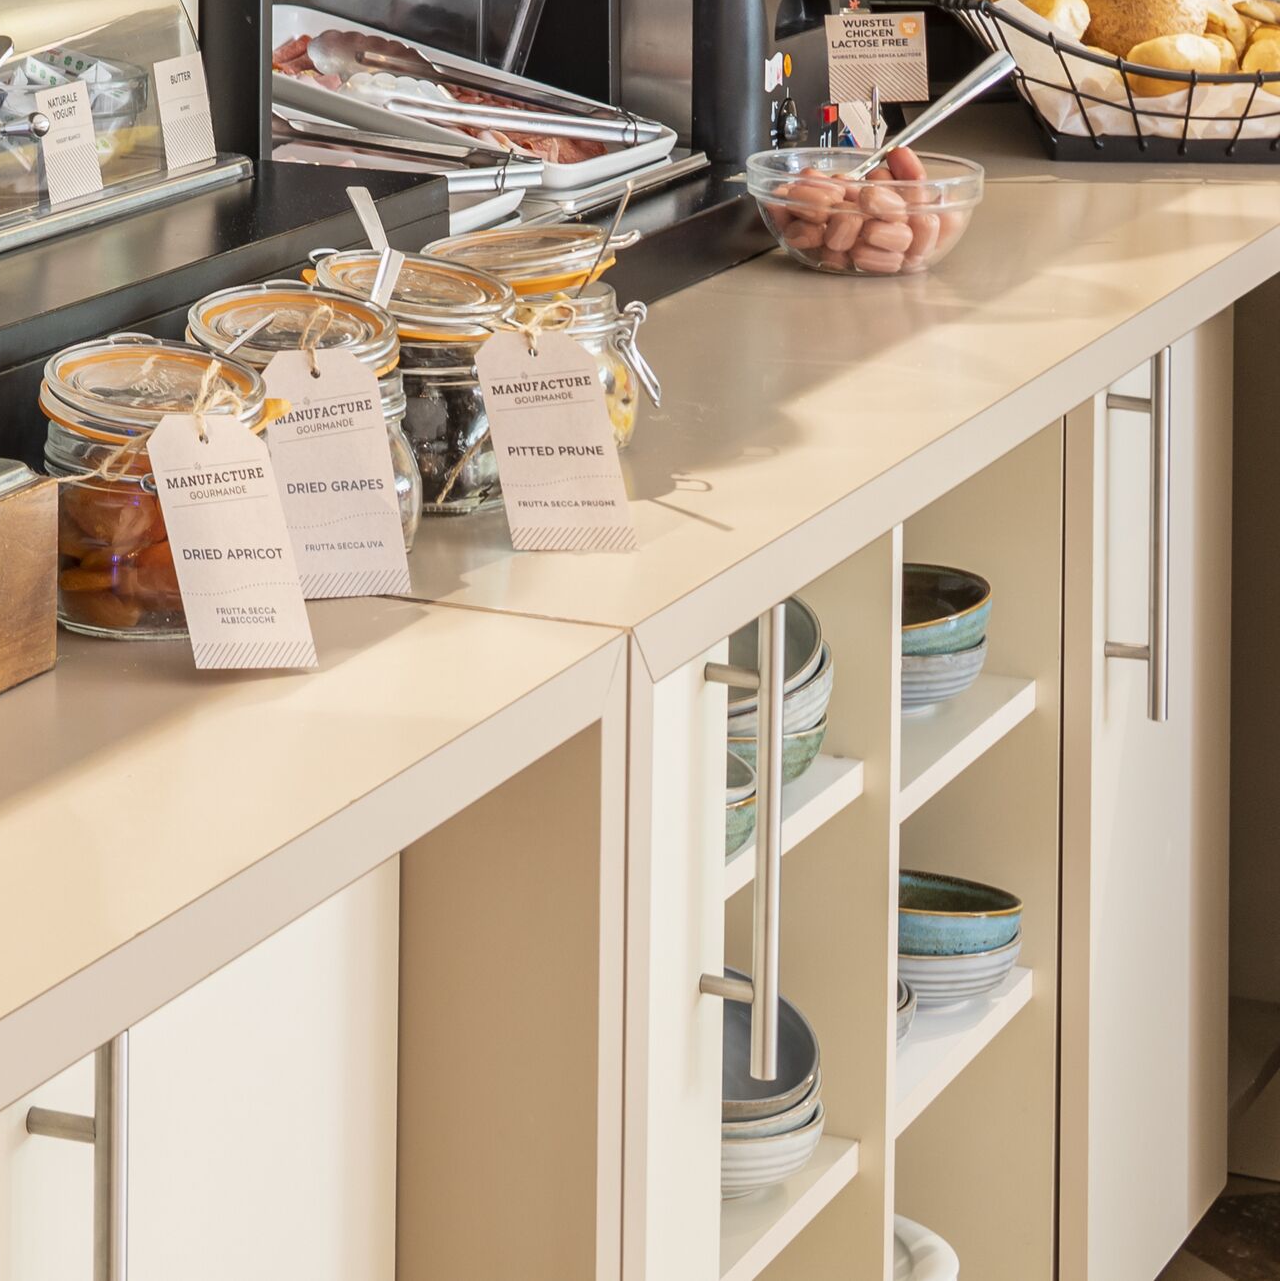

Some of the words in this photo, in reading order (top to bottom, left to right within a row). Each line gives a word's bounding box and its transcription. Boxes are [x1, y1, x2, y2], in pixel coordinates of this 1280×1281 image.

[843, 19, 895, 28] WURSTEL
[845, 29, 893, 38] CHICKEN
[831, 39, 879, 49] LACTOSE
[882, 38, 908, 47] FREE
[170, 71, 191, 85] BUTTER
[47, 92, 78, 109] NATURALE
[52, 106, 76, 120] YOGURT
[491, 375, 592, 395] MANUFACTURE
[514, 391, 573, 405] GOURMANDE
[275, 400, 373, 426] MANUFACTURE
[296, 418, 354, 435] GOURMANDE
[507, 446, 554, 456] PITTED
[558, 446, 604, 456] PRUNE
[166, 467, 264, 489] MANUFACTURE
[190, 485, 247, 500] GOURMANDE
[286, 481, 327, 494] DRIED
[331, 479, 384, 491] GRAPES
[305, 543, 335, 552] FRUTTA
[337, 542, 366, 550] SECCA
[367, 540, 384, 548] UVA
[183, 548, 223, 560] DRIED
[227, 548, 284, 560] APRICOT
[216, 607, 247, 615] FRUTTA
[248, 607, 277, 615] SECCA
[221, 616, 276, 624] ALBICCOCHE
